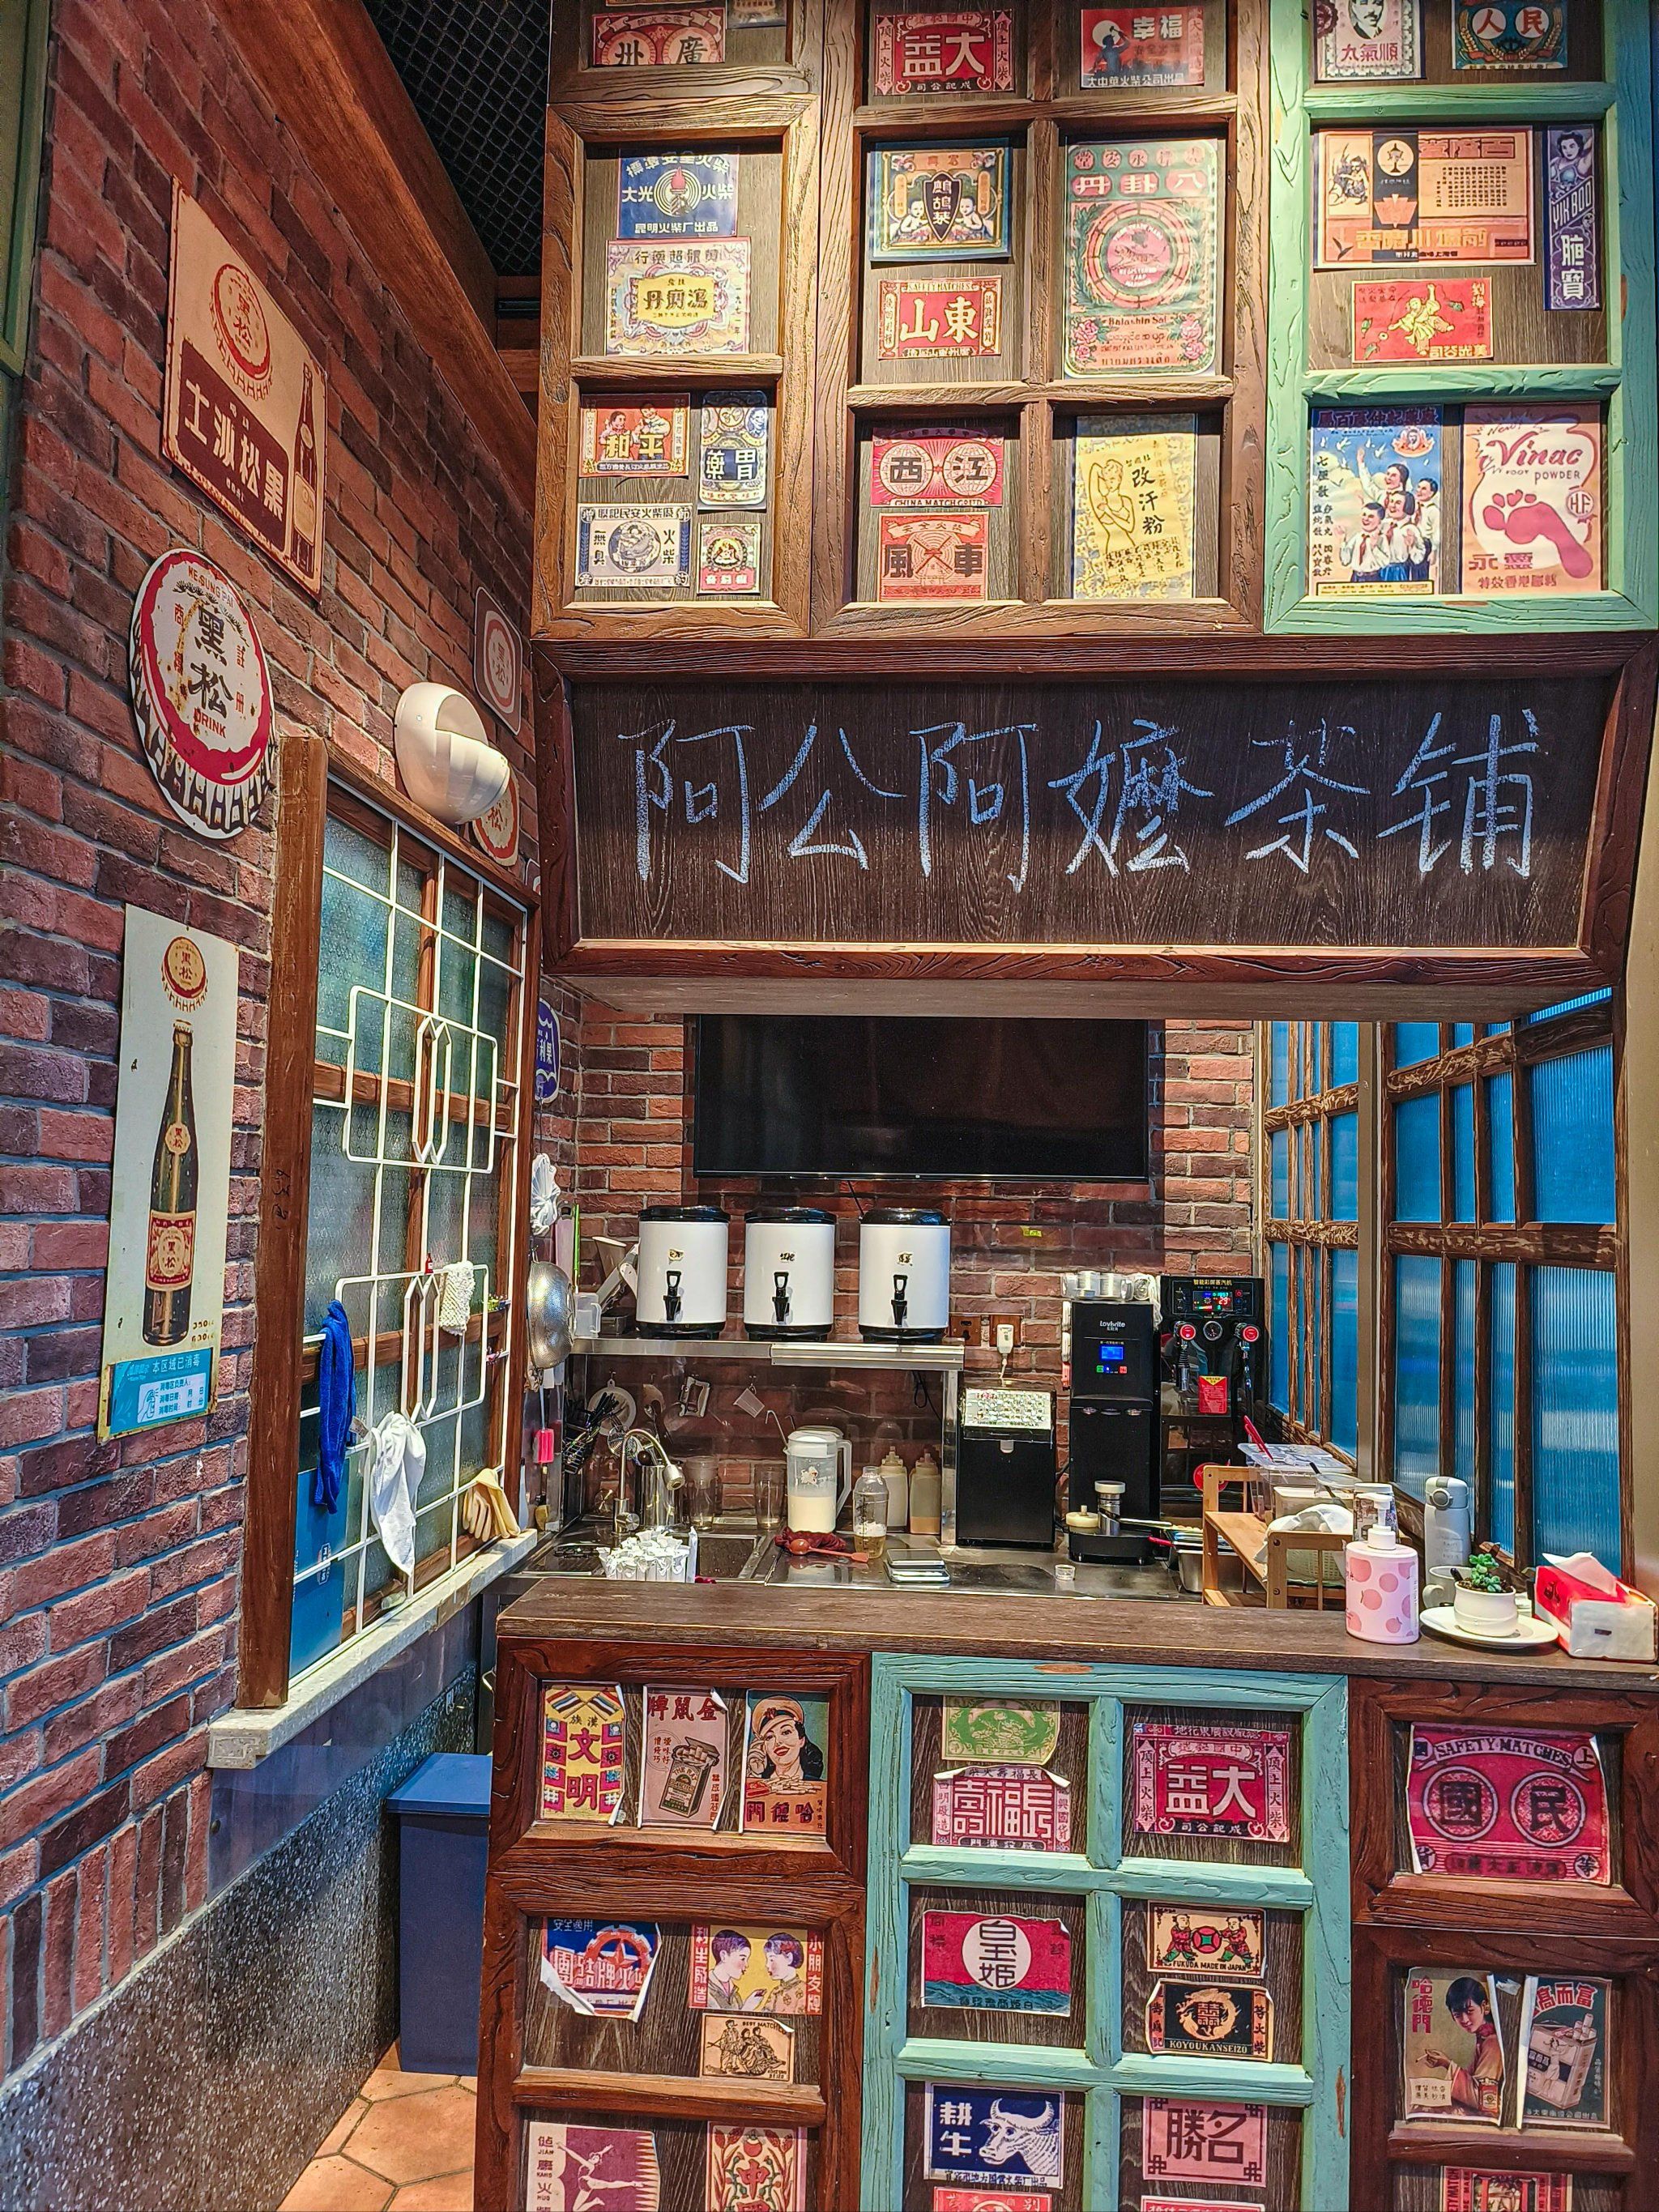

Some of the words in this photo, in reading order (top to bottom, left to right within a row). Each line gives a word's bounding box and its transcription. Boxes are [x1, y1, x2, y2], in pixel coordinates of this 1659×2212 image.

[1132, 14, 1183, 40] 幸福
[1477, 9, 1545, 35] 人民
[622, 185, 654, 202] 大光
[701, 185, 734, 202] 火柴
[604, 433, 664, 460] 和平
[1486, 431, 1584, 467] Vinac
[663, 530, 675, 565] 火柴
[884, 543, 983, 578] 風車
[187, 603, 234, 719] 黑松
[194, 707, 227, 739] DRINK
[152, 1353, 201, 1374] 本区域已消毒
[1435, 1737, 1499, 1758] SAFETY
[1499, 1738, 1572, 1767] MATCHES
[567, 1728, 601, 1810] 文明
[1173, 1960, 1199, 1969] FUKUDA
[1201, 1962, 1219, 1970] MADE
[1227, 1963, 1247, 1971] JAPAN
[939, 2101, 972, 2157] 耕牛
